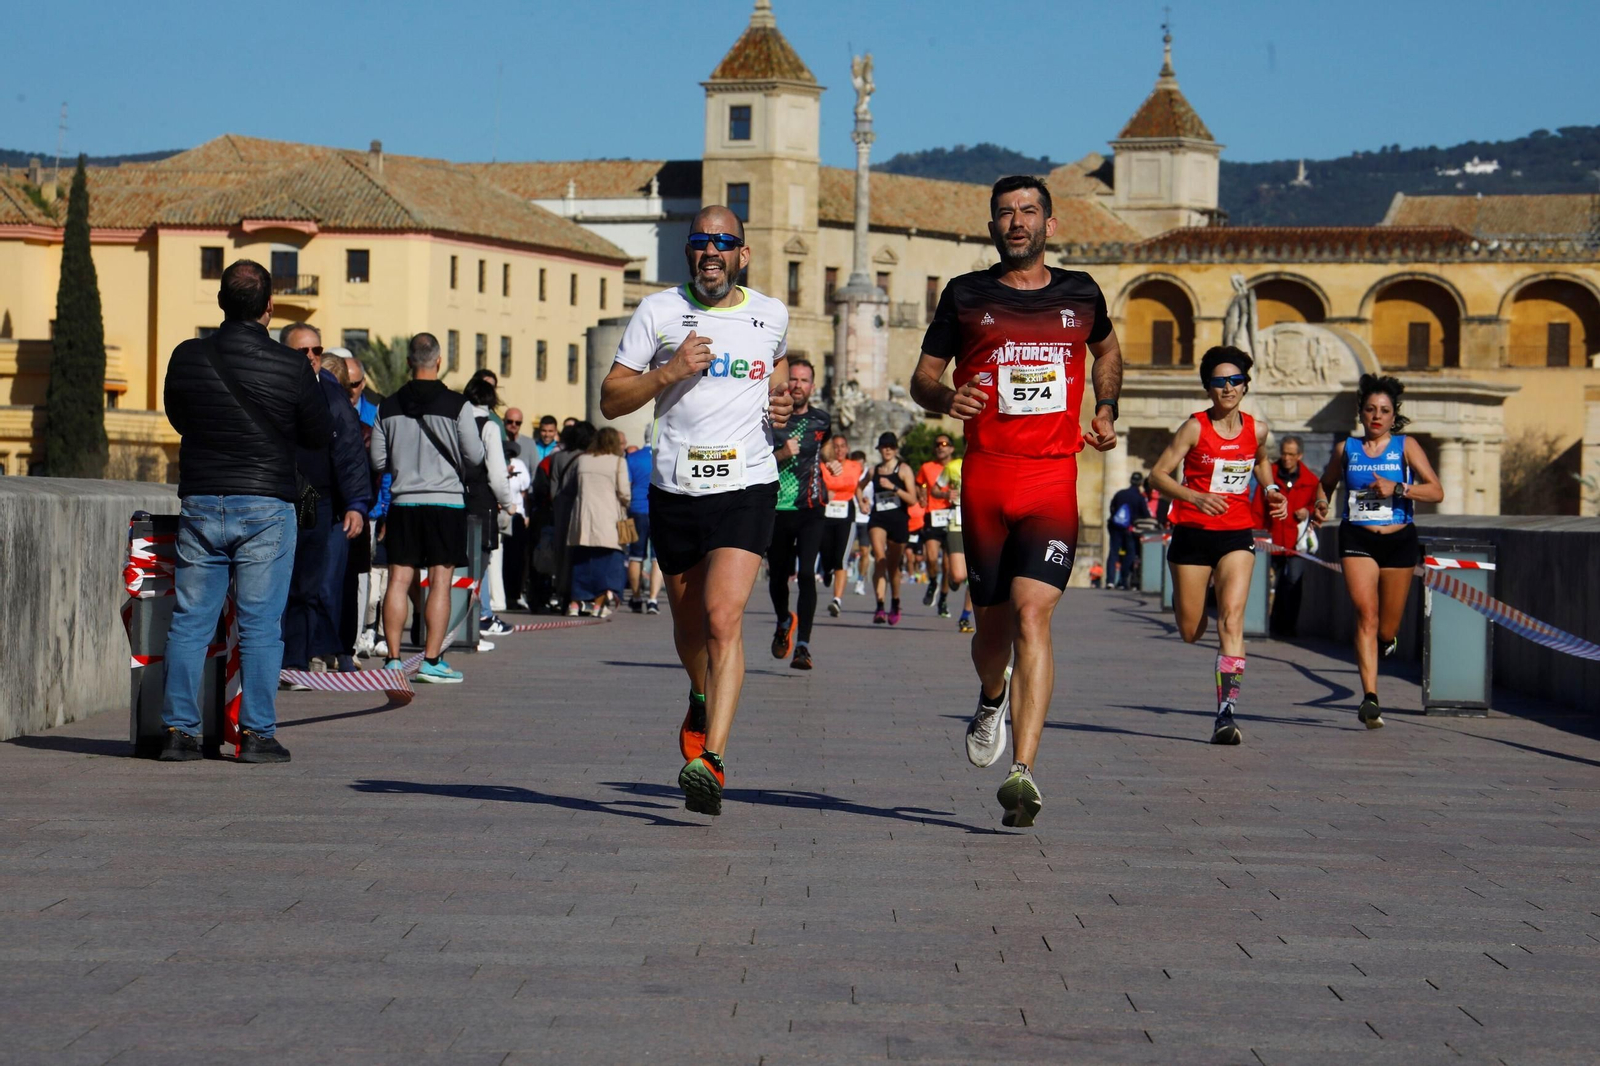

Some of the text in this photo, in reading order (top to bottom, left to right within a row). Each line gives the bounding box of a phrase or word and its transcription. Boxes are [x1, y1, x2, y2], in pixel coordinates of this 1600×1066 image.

[997, 346, 1065, 365] ANTORCHA
[1013, 386, 1052, 402] 574
[691, 464, 730, 478] 195
[1223, 475, 1246, 485] 177
[1358, 502, 1380, 511] 312
